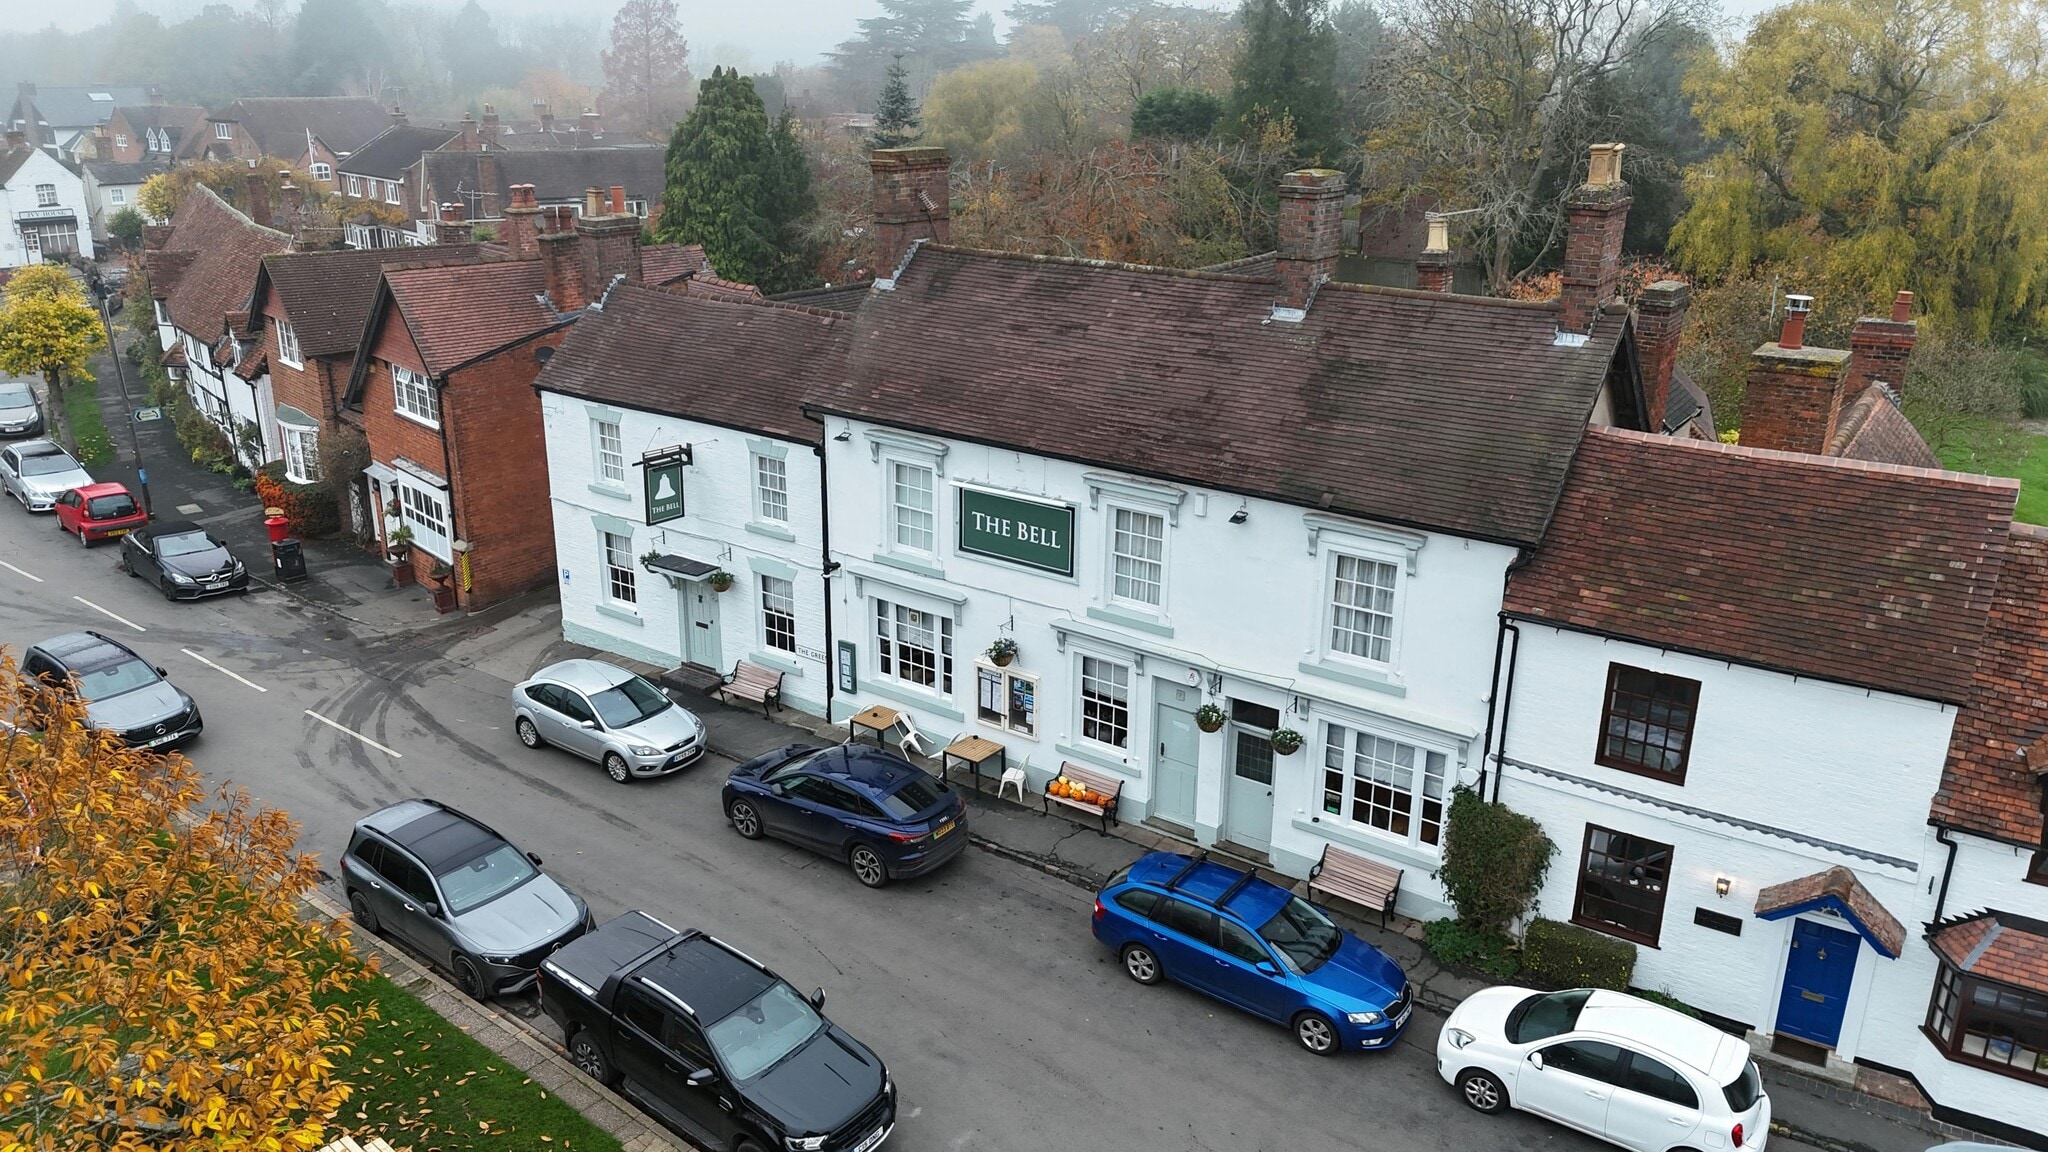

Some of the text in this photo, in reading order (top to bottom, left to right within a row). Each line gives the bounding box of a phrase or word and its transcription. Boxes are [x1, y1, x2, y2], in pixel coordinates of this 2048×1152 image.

[652, 502, 680, 514] THE BELL
[971, 511, 1061, 549] THE BELL
[798, 647, 827, 661] THE GREE
